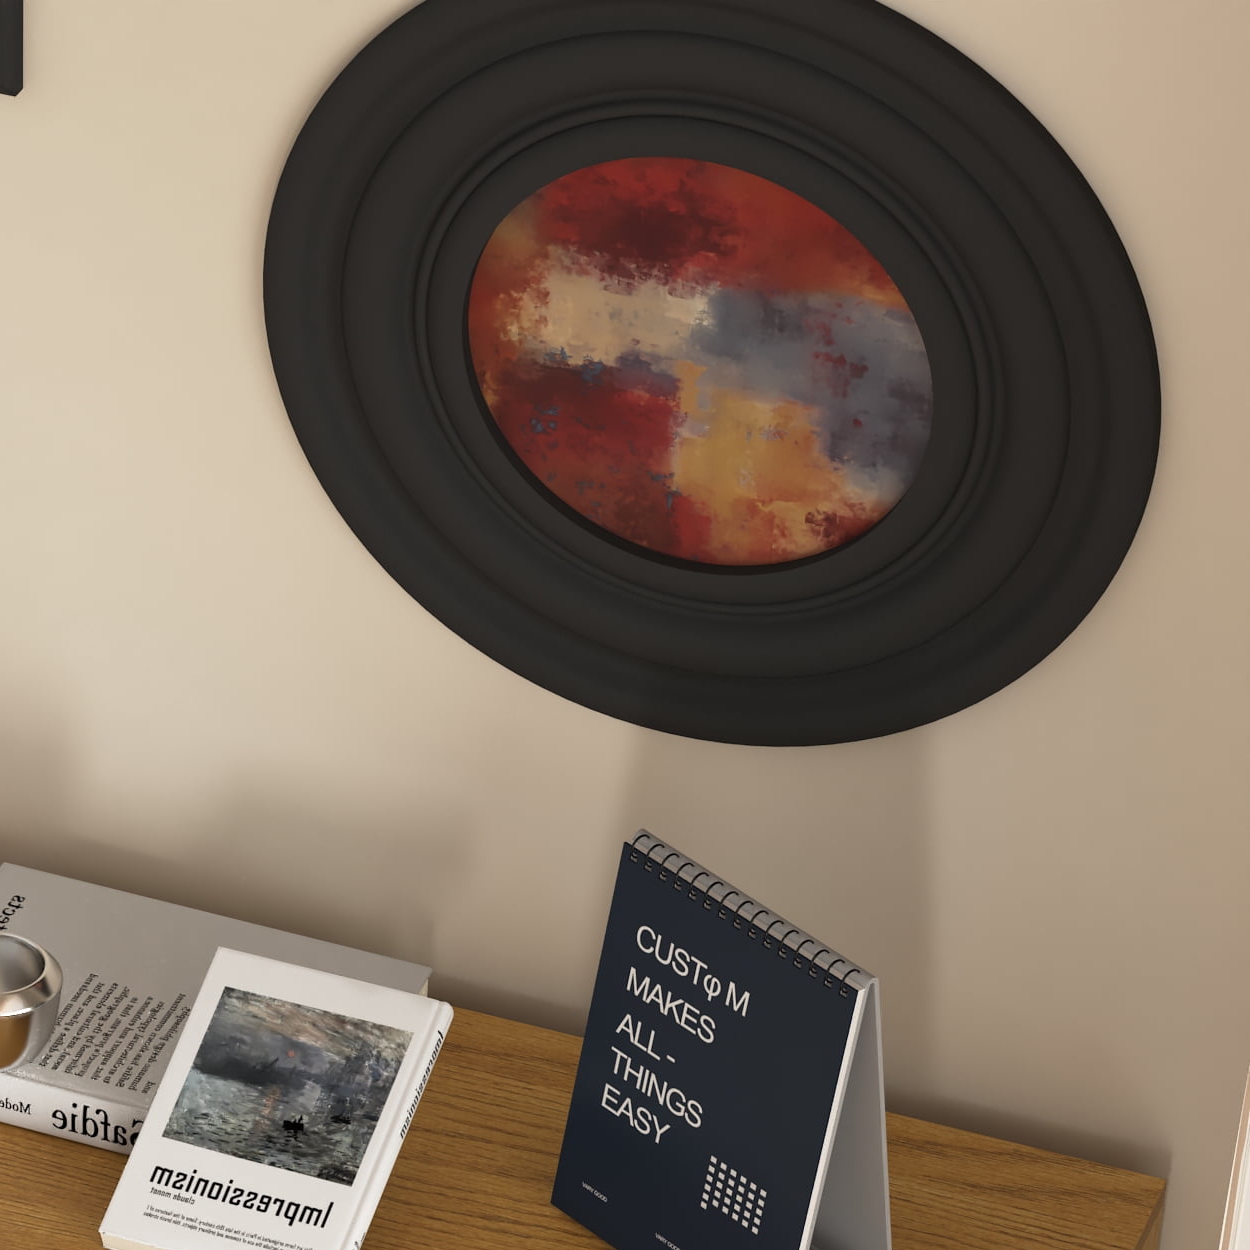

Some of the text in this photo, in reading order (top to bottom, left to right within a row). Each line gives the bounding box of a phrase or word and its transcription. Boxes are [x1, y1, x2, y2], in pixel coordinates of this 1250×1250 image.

[626, 966, 716, 1044] MAKES
[601, 1083, 671, 1144] EASY
[611, 1046, 703, 1128] THINGS
